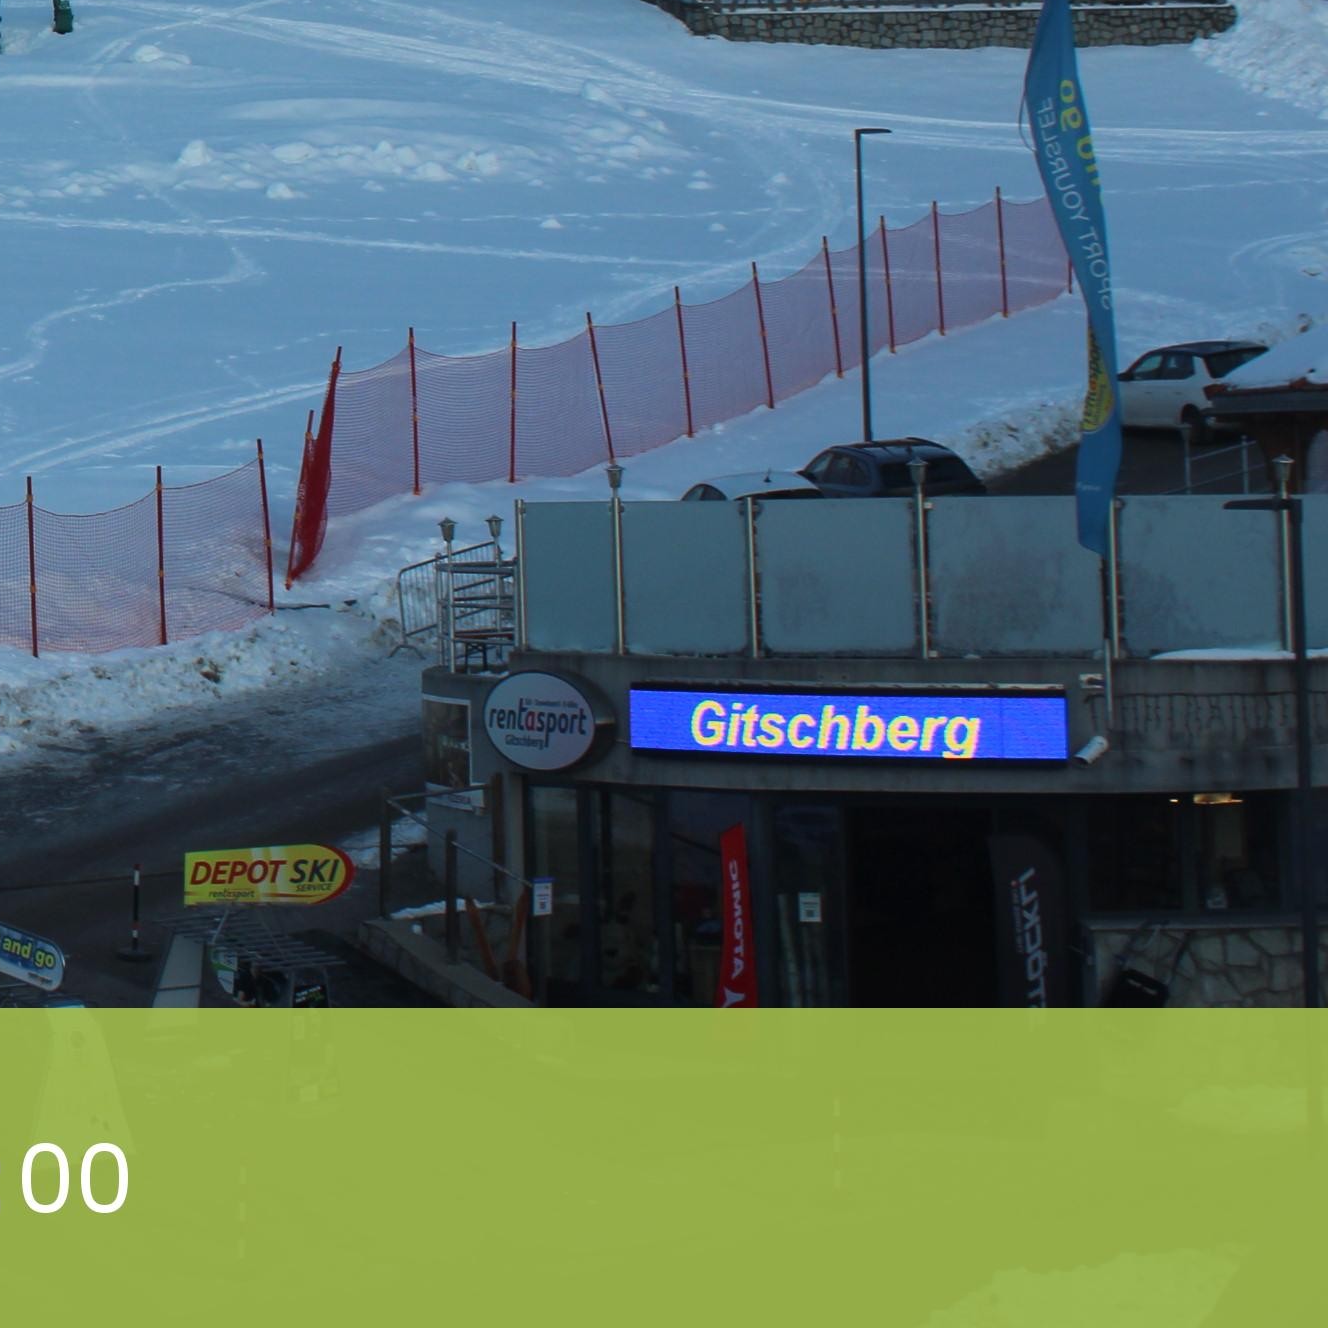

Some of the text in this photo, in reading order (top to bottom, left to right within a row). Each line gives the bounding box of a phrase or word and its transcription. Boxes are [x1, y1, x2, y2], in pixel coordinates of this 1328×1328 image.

[489, 697, 587, 749] rentasport
[691, 700, 981, 759] Gitschberg
[189, 858, 340, 886] DEPOT SKI
[295, 883, 334, 893] SERVICE
[2, 937, 32, 959] and
[34, 949, 55, 969] go
